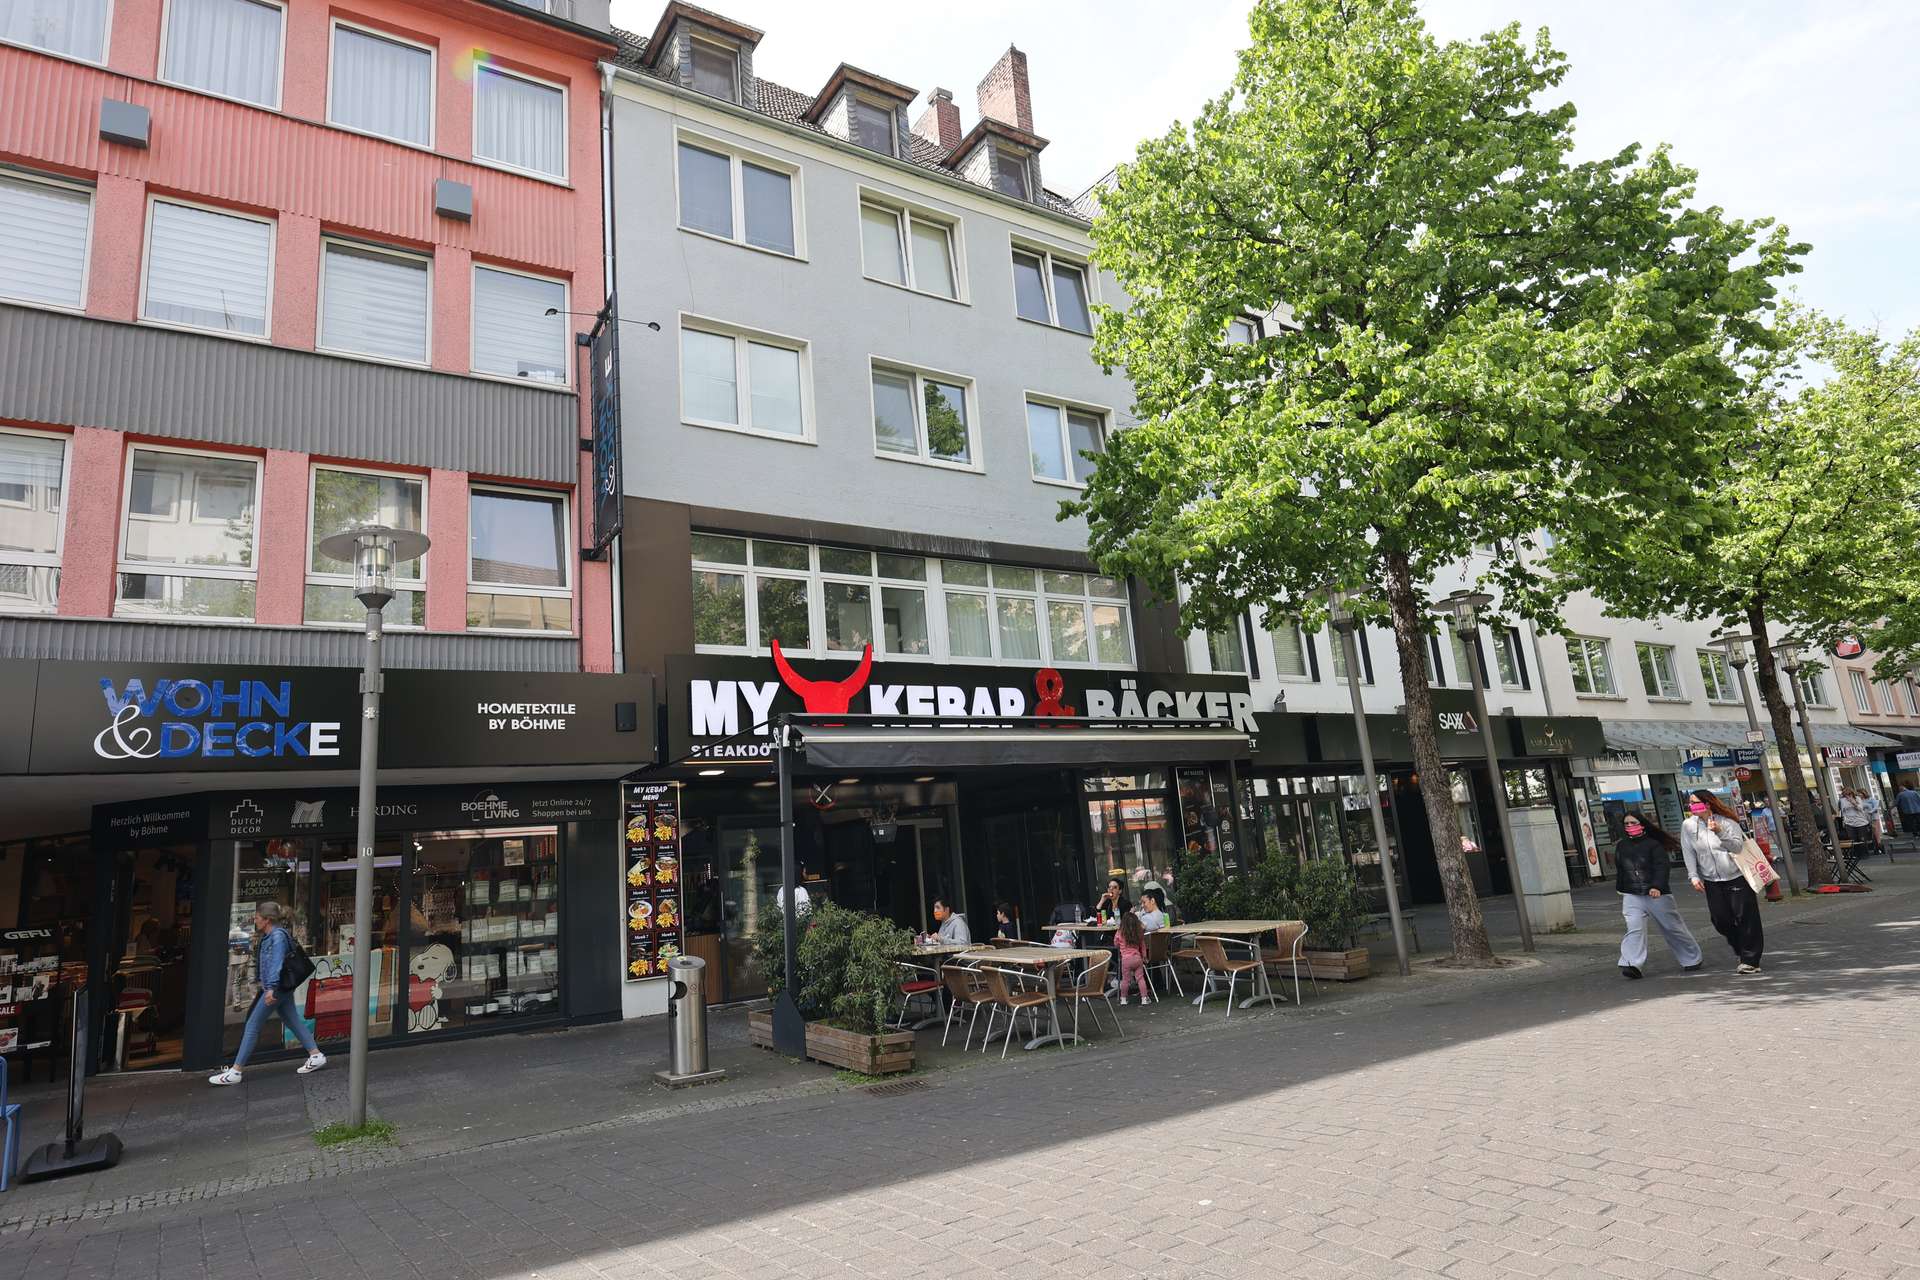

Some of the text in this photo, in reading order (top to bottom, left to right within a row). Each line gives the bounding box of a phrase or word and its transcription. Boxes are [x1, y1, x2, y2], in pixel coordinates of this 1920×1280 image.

[100, 678, 291, 717] WOHN
[477, 703, 576, 715] HOMETEXTILE
[691, 680, 780, 736] MY
[1085, 679, 1260, 732] BÄCKER
[489, 716, 566, 730] BY BÖHME
[159, 722, 341, 757] DECKE
[690, 743, 771, 757] STEAKDÖ
[633, 786, 645, 794] MY
[461, 801, 508, 811] BOEHME
[532, 799, 592, 808] Jetzt Online 24/7
[350, 804, 417, 817] HRDING
[484, 809, 520, 819] LIVING
[532, 809, 564, 819] Shoppen
[110, 810, 191, 828] Herzlich Willkommen
[230, 818, 262, 826] DUTCH
[130, 825, 169, 839] by Böhme
[230, 826, 261, 834] DECOR
[362, 847, 373, 857] 10
[4, 929, 52, 940] GEFU
